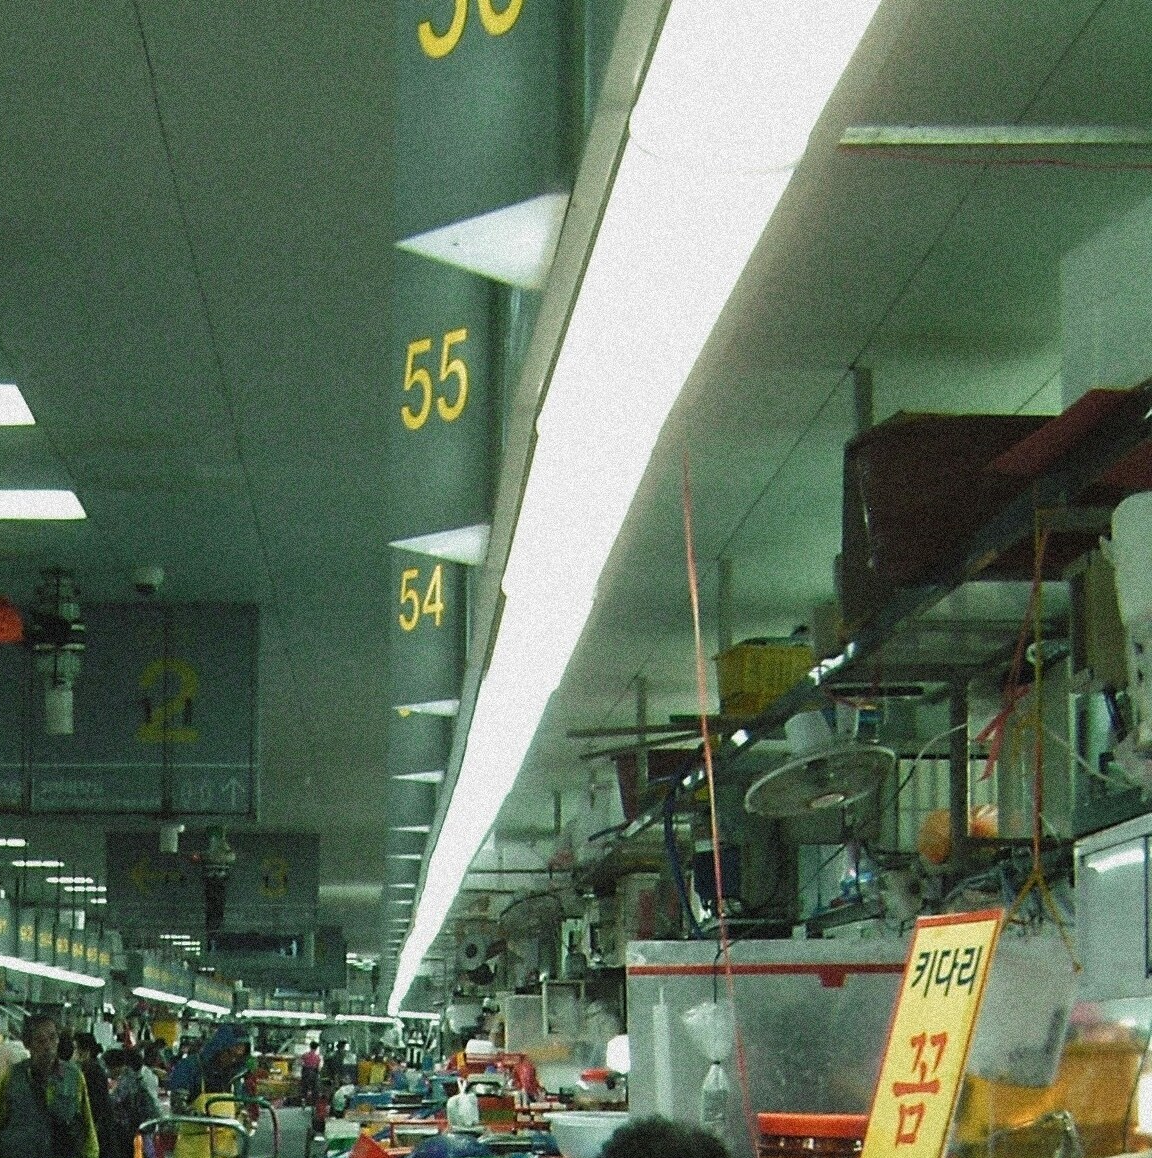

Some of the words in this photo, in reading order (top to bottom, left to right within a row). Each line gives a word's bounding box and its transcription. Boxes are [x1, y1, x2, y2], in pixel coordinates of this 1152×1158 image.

[401, 327, 471, 432] 55
[400, 565, 446, 631] 54
[134, 657, 200, 744] 2
[910, 945, 984, 998] 키다리
